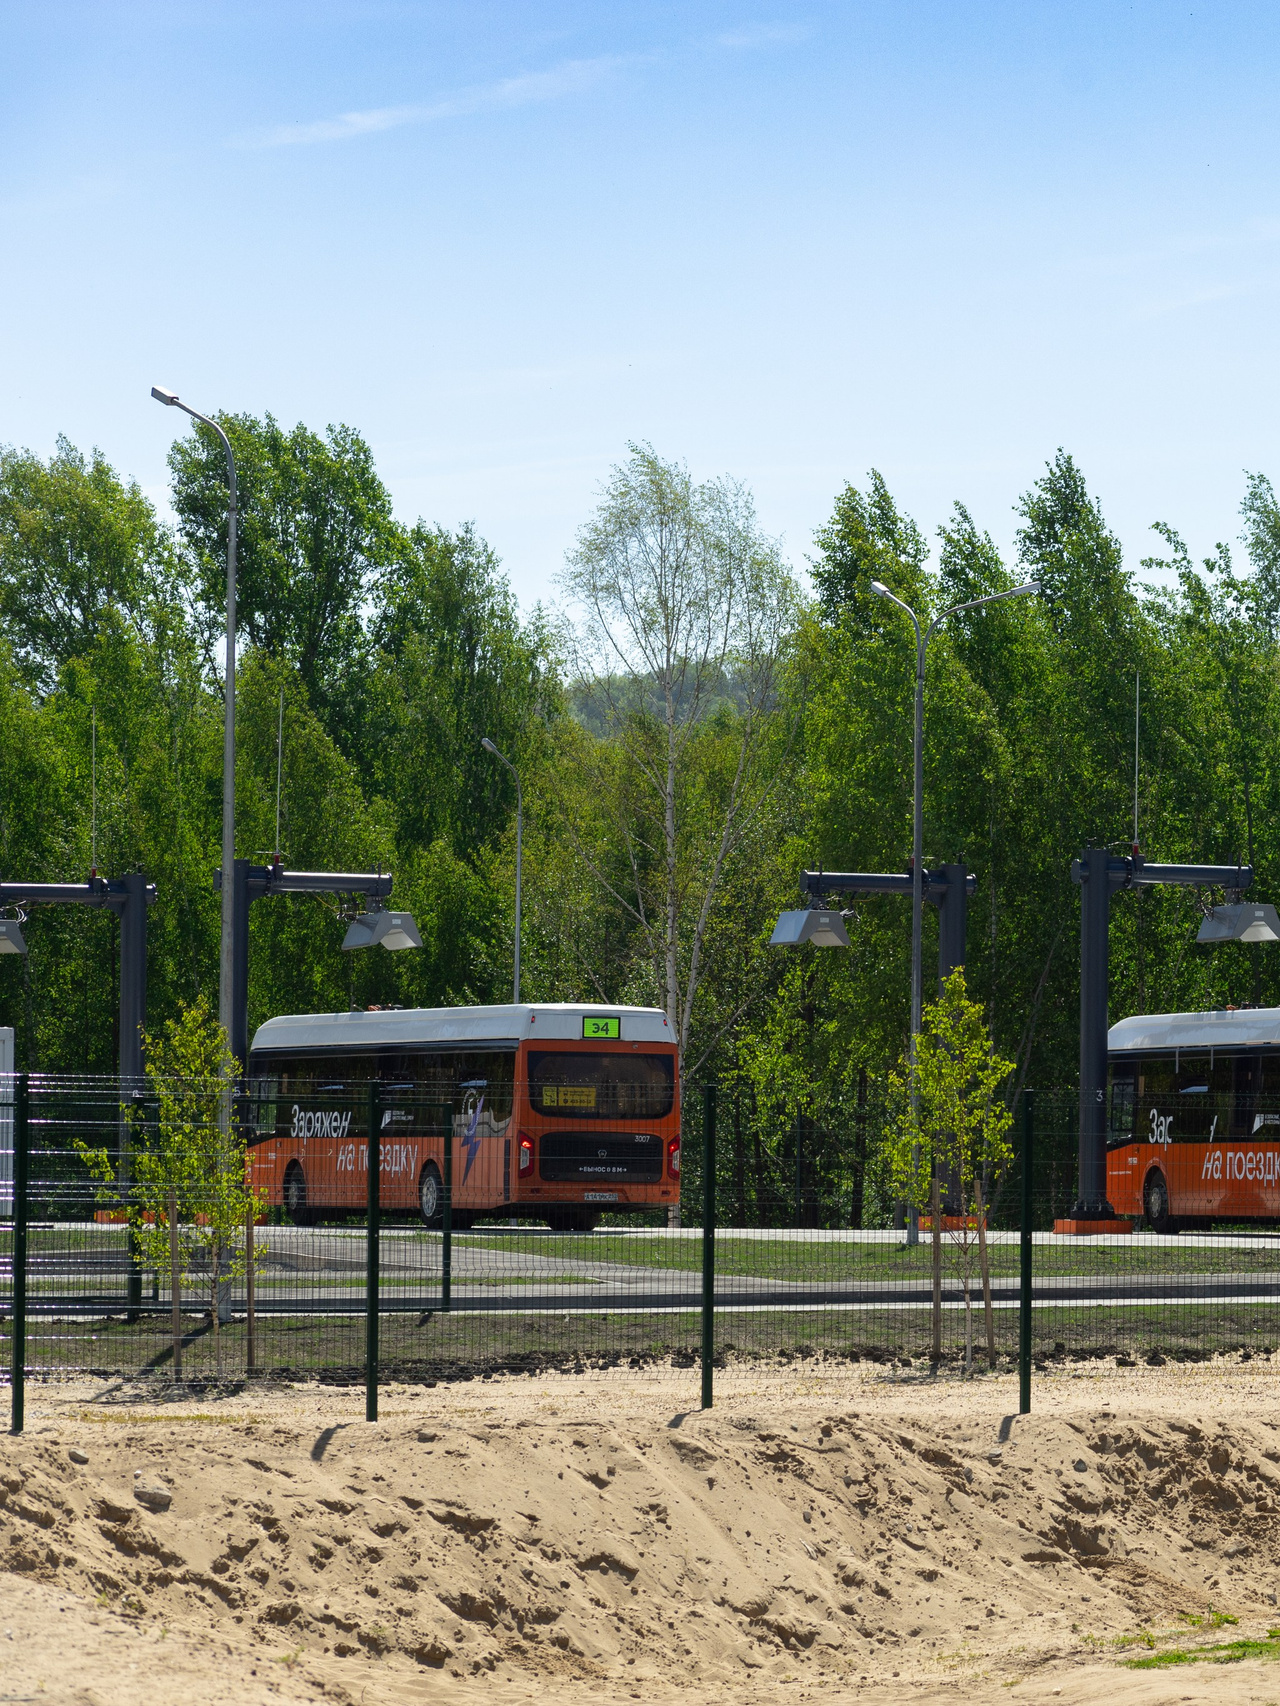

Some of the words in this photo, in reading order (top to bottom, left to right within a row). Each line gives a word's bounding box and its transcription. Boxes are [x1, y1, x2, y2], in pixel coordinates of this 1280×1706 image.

[1096, 1090, 1103, 1101] 3
[291, 1104, 352, 1145] Заряжен
[634, 1135, 651, 1143] 3007
[336, 1143, 355, 1171] на
[1201, 1150, 1223, 1180] на
